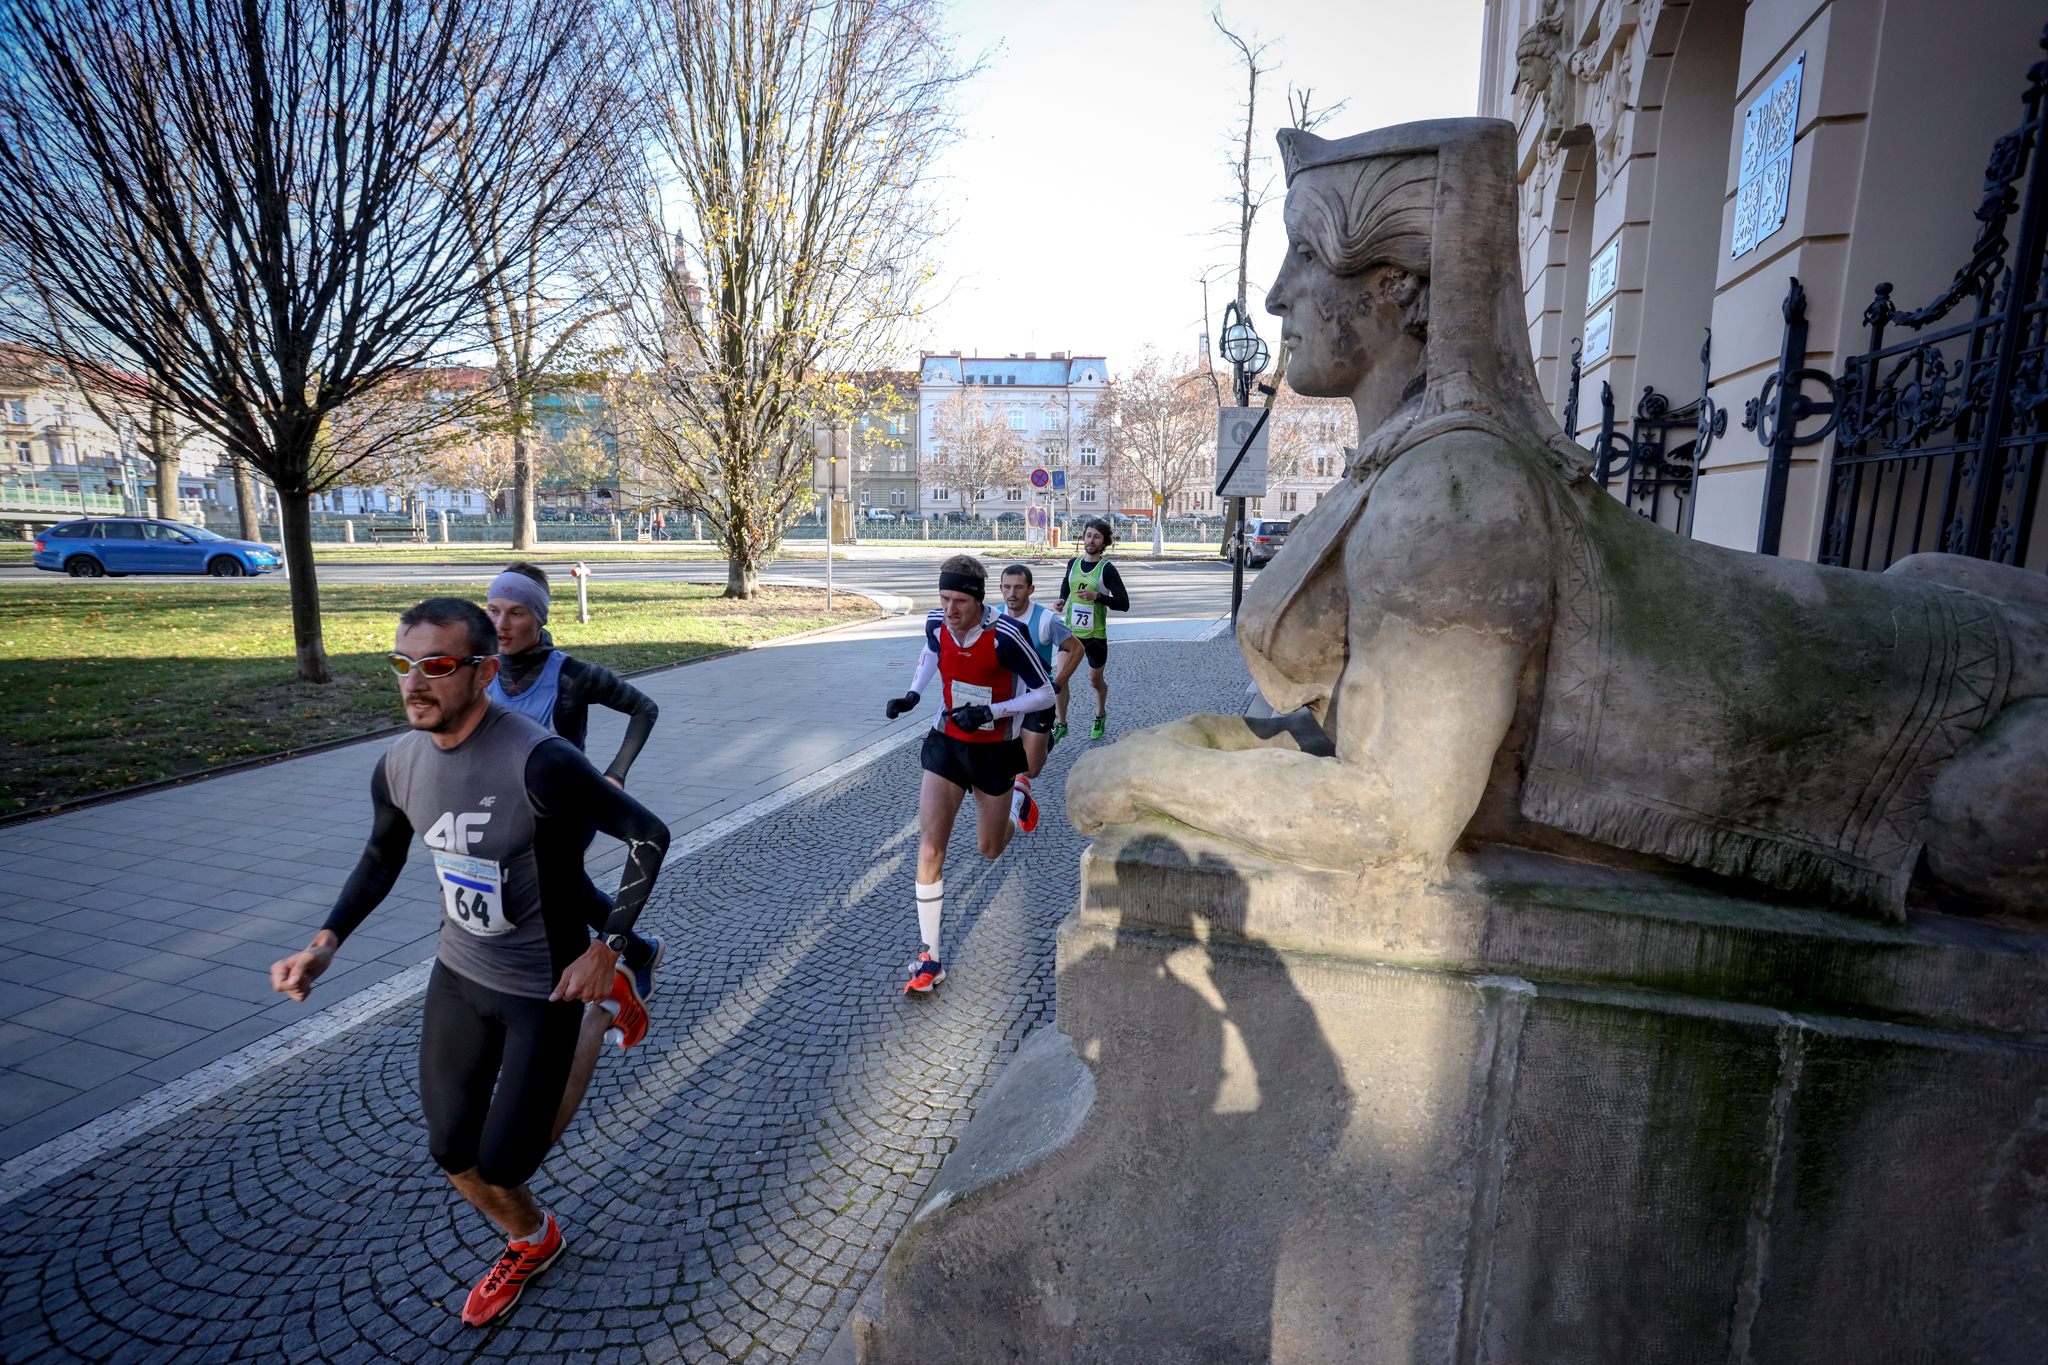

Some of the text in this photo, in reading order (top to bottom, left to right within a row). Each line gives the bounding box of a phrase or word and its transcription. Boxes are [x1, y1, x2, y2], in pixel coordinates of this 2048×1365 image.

[1244, 408, 1262, 419] ZÓN
[1076, 613, 1089, 626] 73
[479, 796, 496, 807] 4F
[423, 811, 492, 855] 4F
[455, 886, 490, 929] 64
